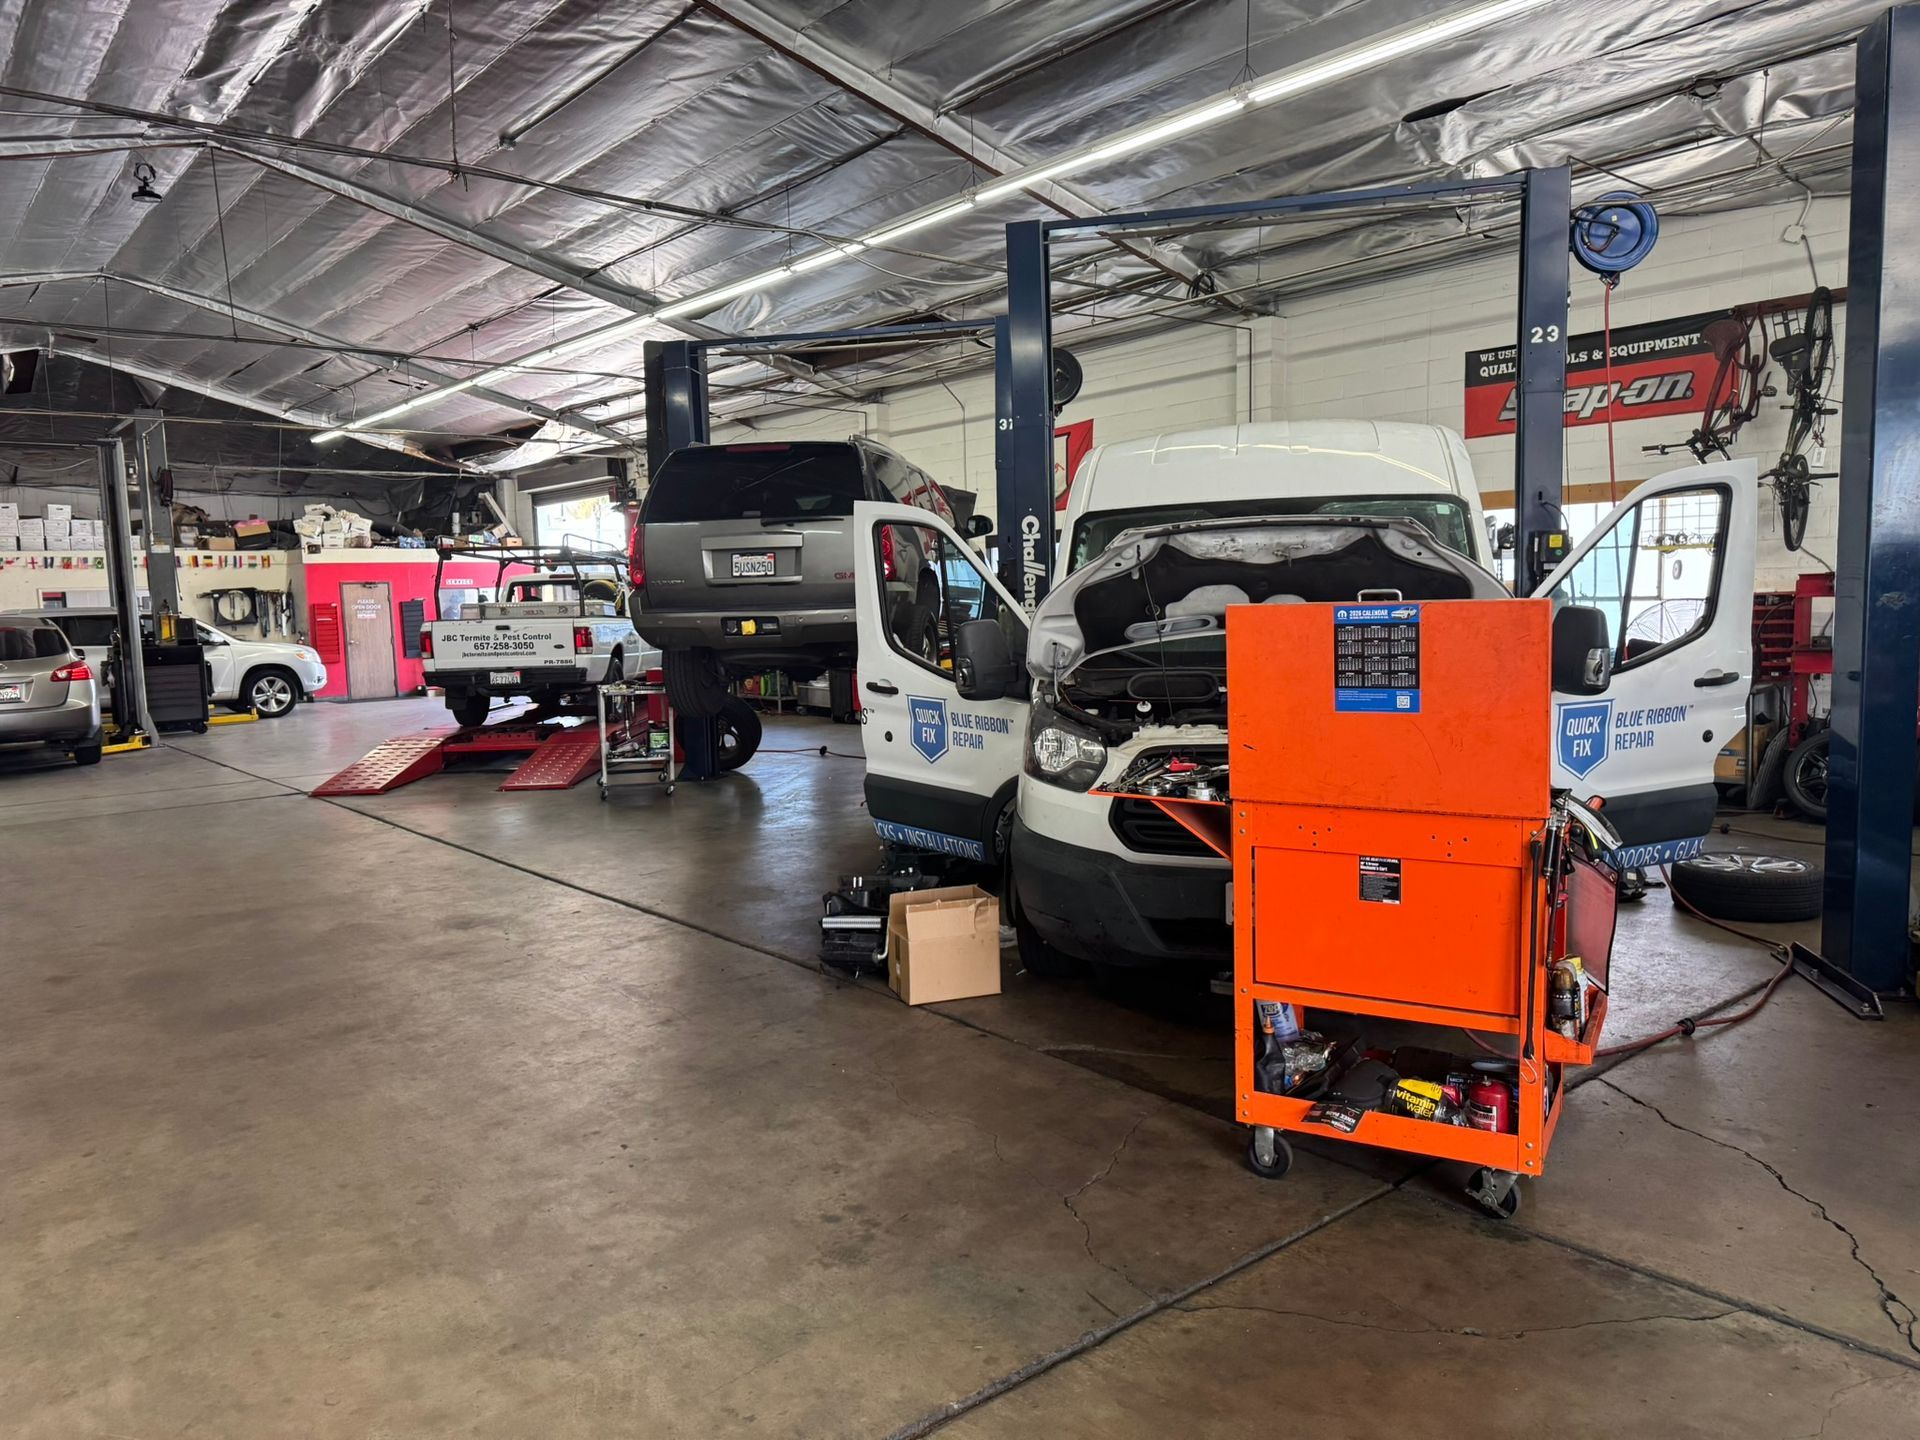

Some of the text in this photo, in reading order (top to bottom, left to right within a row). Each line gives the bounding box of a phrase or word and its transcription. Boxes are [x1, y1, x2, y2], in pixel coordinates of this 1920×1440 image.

[1530, 325, 1560, 344] 23
[1479, 362, 1516, 378] QUAL
[1593, 348, 1604, 360] &
[1609, 333, 1701, 358] EQUIPMENT
[1479, 349, 1517, 363] WE USE
[1021, 515, 1046, 620] Challeng
[1362, 609, 1388, 617] CALENDAR
[441, 633, 458, 642] JBC
[460, 632, 491, 642] Termite
[502, 632, 521, 641] Pest
[523, 632, 552, 641] Control
[473, 641, 535, 651] 657-258-3050
[915, 707, 942, 726] QUICK
[950, 711, 974, 729] BLUE
[1566, 715, 1602, 737] QUICK
[1615, 709, 1645, 729] BLUE
[921, 727, 937, 744] FIX
[952, 731, 984, 750] REPAIR
[1615, 730, 1655, 751] REPAIR
[1573, 738, 1592, 758] FIX
[904, 828, 982, 861] INSTALLATIONS
[1396, 1088, 1436, 1111] vitamin
[1406, 1101, 1434, 1118] water
